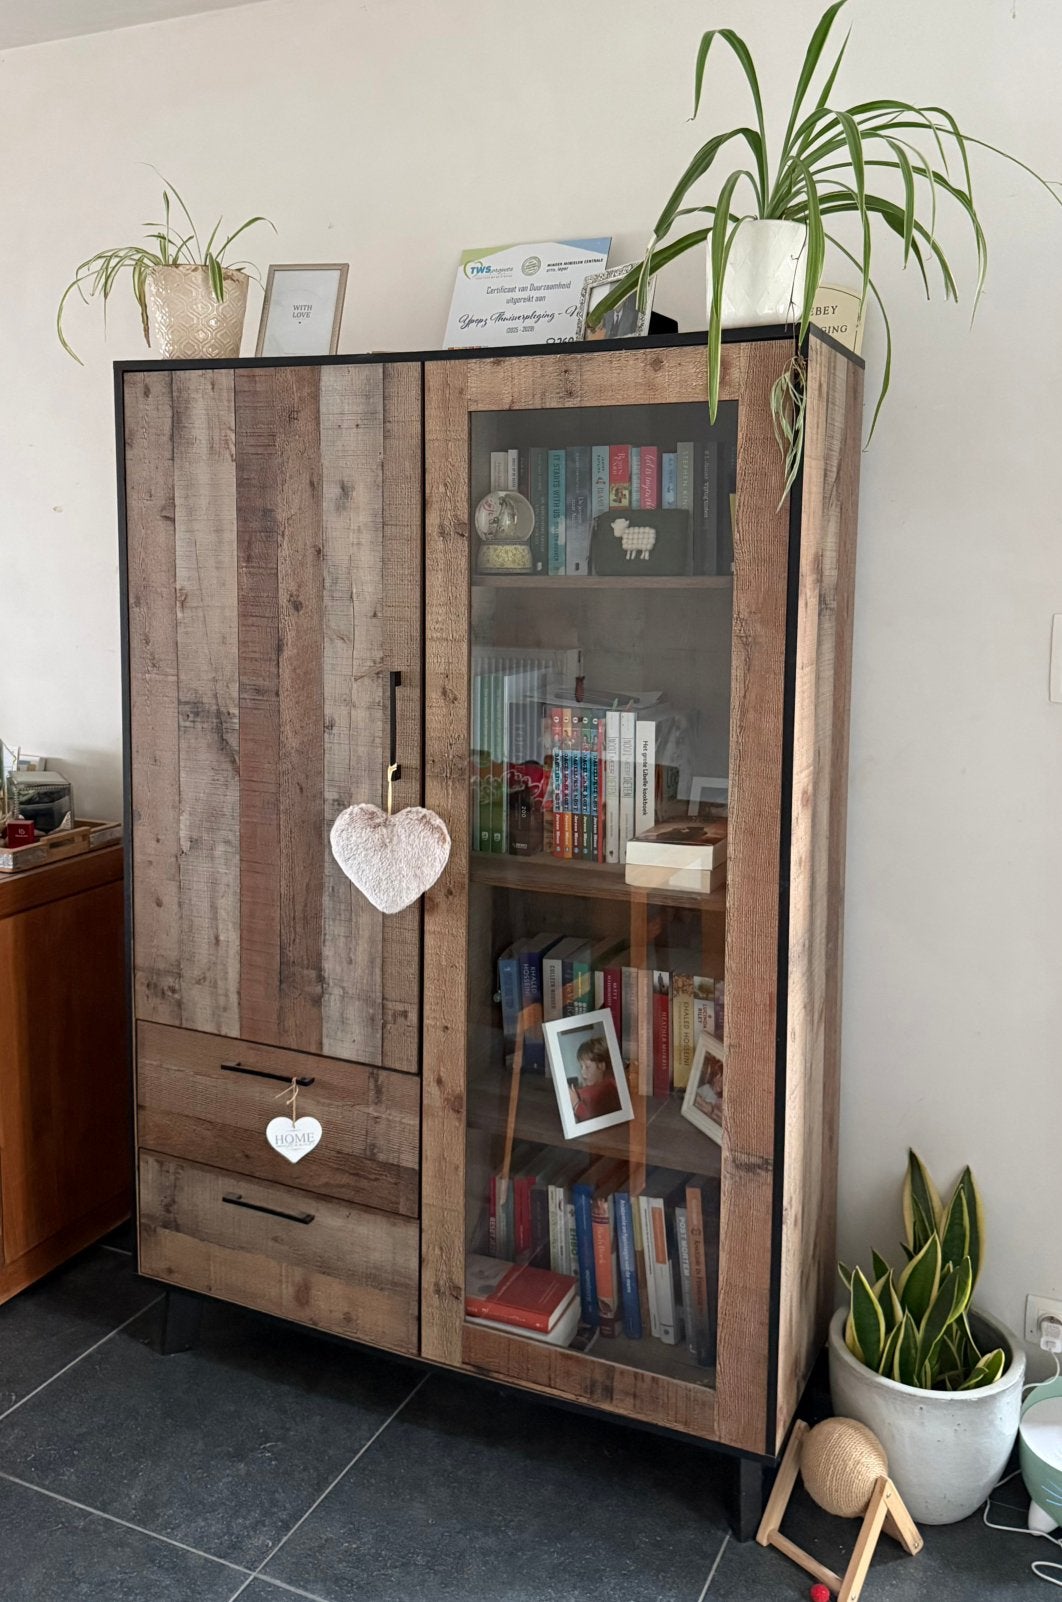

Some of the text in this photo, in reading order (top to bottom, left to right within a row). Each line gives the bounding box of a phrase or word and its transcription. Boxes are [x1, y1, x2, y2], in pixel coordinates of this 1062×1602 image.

[470, 264, 492, 275] TWS
[486, 284, 517, 296] Certificaat
[529, 281, 571, 293] Duurzaamheid
[506, 295, 546, 305] uitgereikt aan
[292, 311, 311, 319] LOVE
[489, 309, 555, 326] Thuisverpleging
[681, 450, 689, 487] STEPHEN
[553, 454, 561, 519] IT STARTS WITH US
[275, 1132, 316, 1145] HOME
[678, 1216, 687, 1239] POST
[680, 1239, 690, 1277] MORTEM
